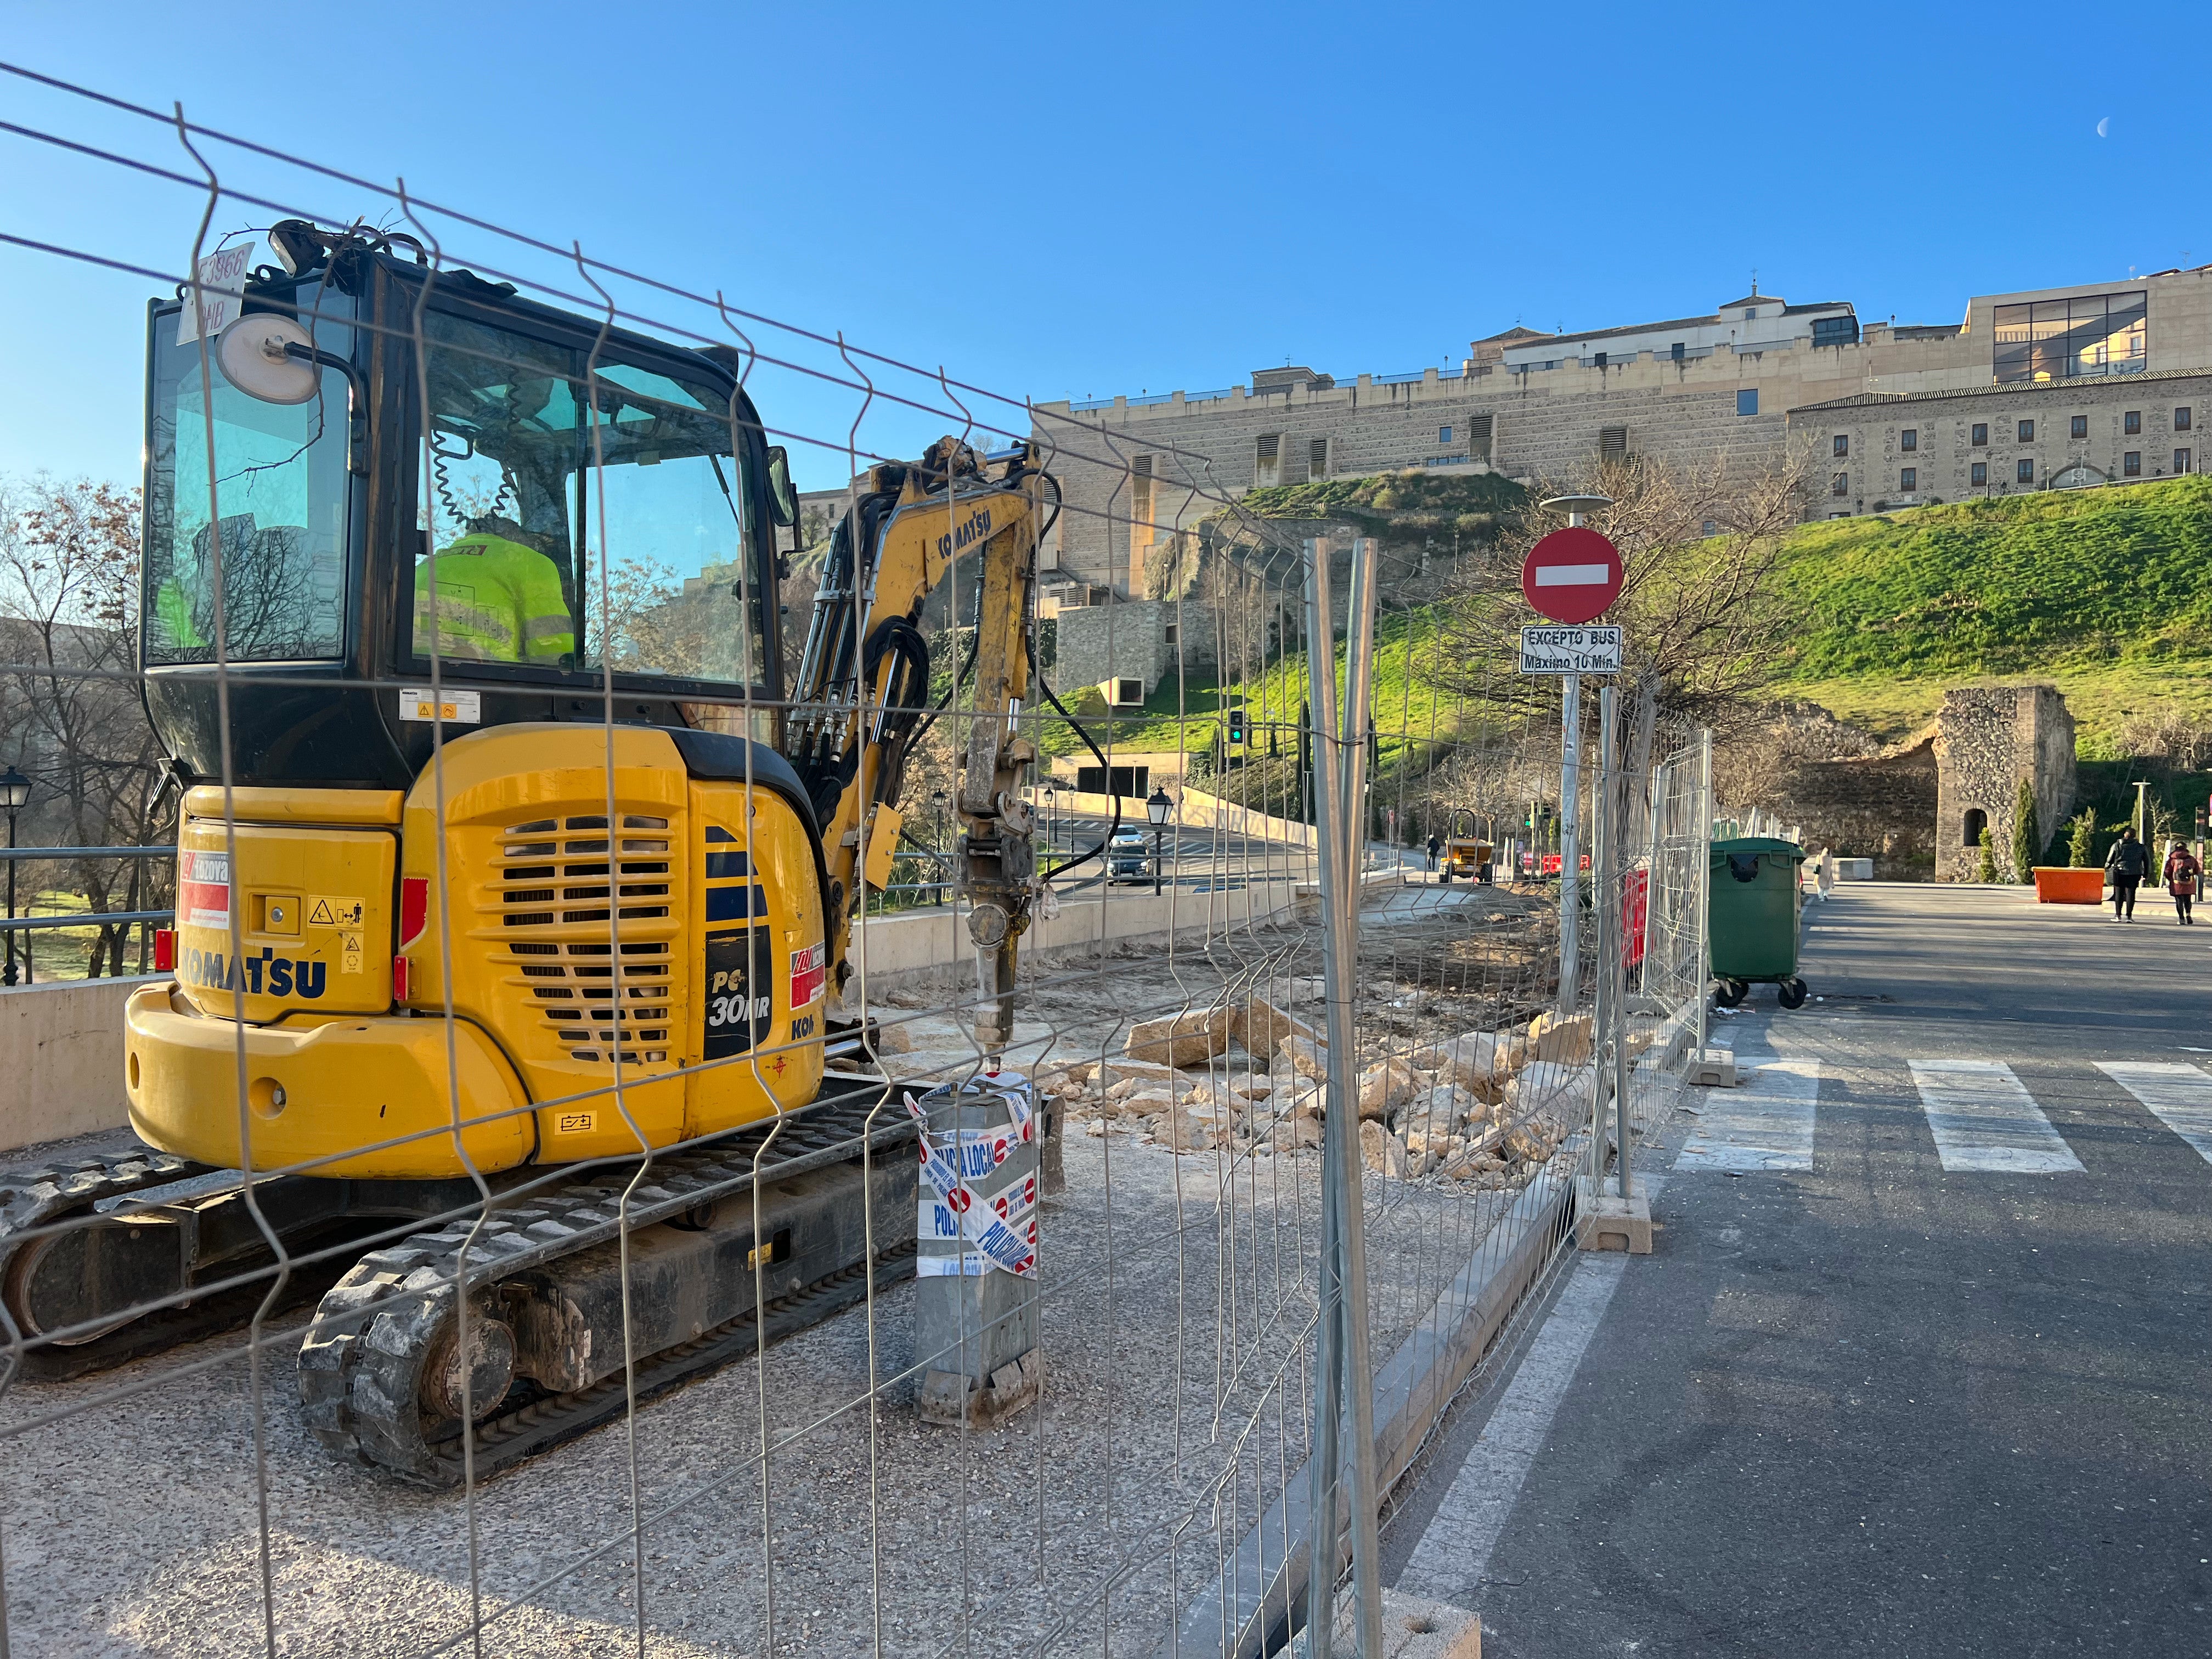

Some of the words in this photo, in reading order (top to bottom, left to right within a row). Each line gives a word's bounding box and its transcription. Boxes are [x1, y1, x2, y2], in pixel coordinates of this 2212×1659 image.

[1528, 631, 1583, 645] EXCEPTO
[1590, 630, 1615, 645] BUS
[1525, 654, 1570, 669] Máximo
[1575, 654, 1588, 668] 10
[182, 946, 326, 998] KOMATSU
[967, 1142, 996, 1177] LOCAL
[934, 1204, 964, 1235] POLI
[977, 1221, 1019, 1263] POLICIA
